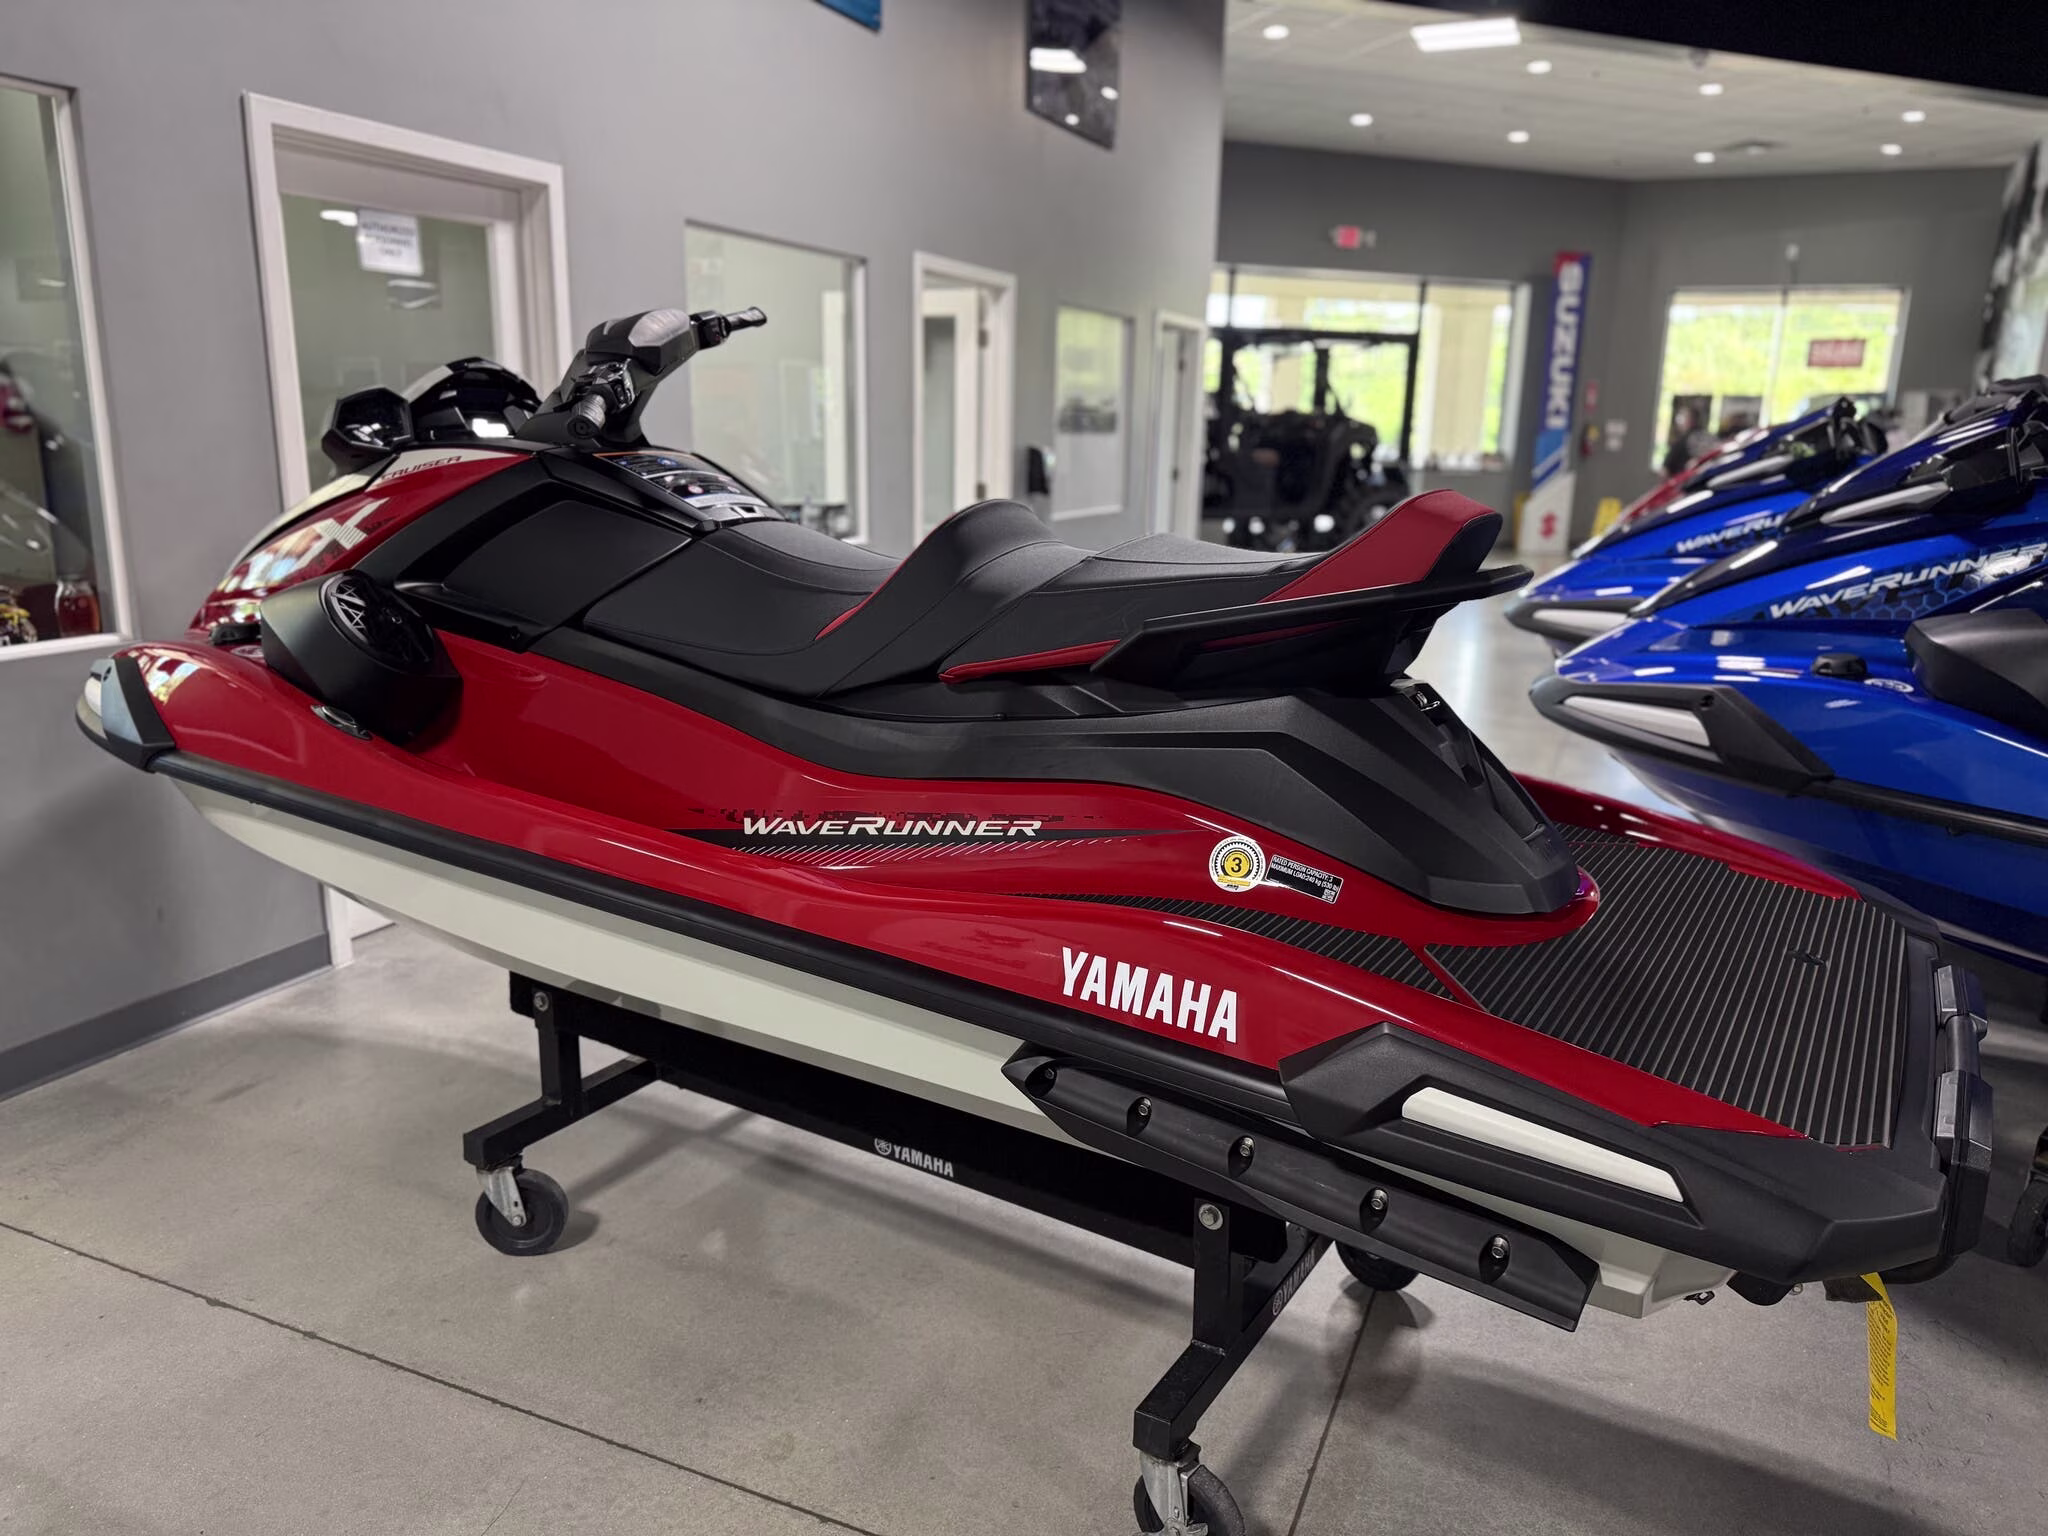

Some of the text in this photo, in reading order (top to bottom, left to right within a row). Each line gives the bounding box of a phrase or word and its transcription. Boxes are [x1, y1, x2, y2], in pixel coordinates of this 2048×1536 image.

[1545, 262, 1584, 430] SUZUKI
[381, 455, 462, 479] CRUISER
[1676, 511, 1788, 554] WAVERU
[1769, 542, 2048, 619] WAVERUNNER
[743, 817, 1042, 836] WAVERUNNER
[1231, 857, 1242, 873] 3
[1271, 862, 1294, 875] MAXIMUM
[1272, 856, 1288, 866] RATED
[1287, 861, 1307, 873] PERSON
[1062, 946, 1237, 1044] YAMAHA
[893, 1144, 954, 1178] YAMAHA
